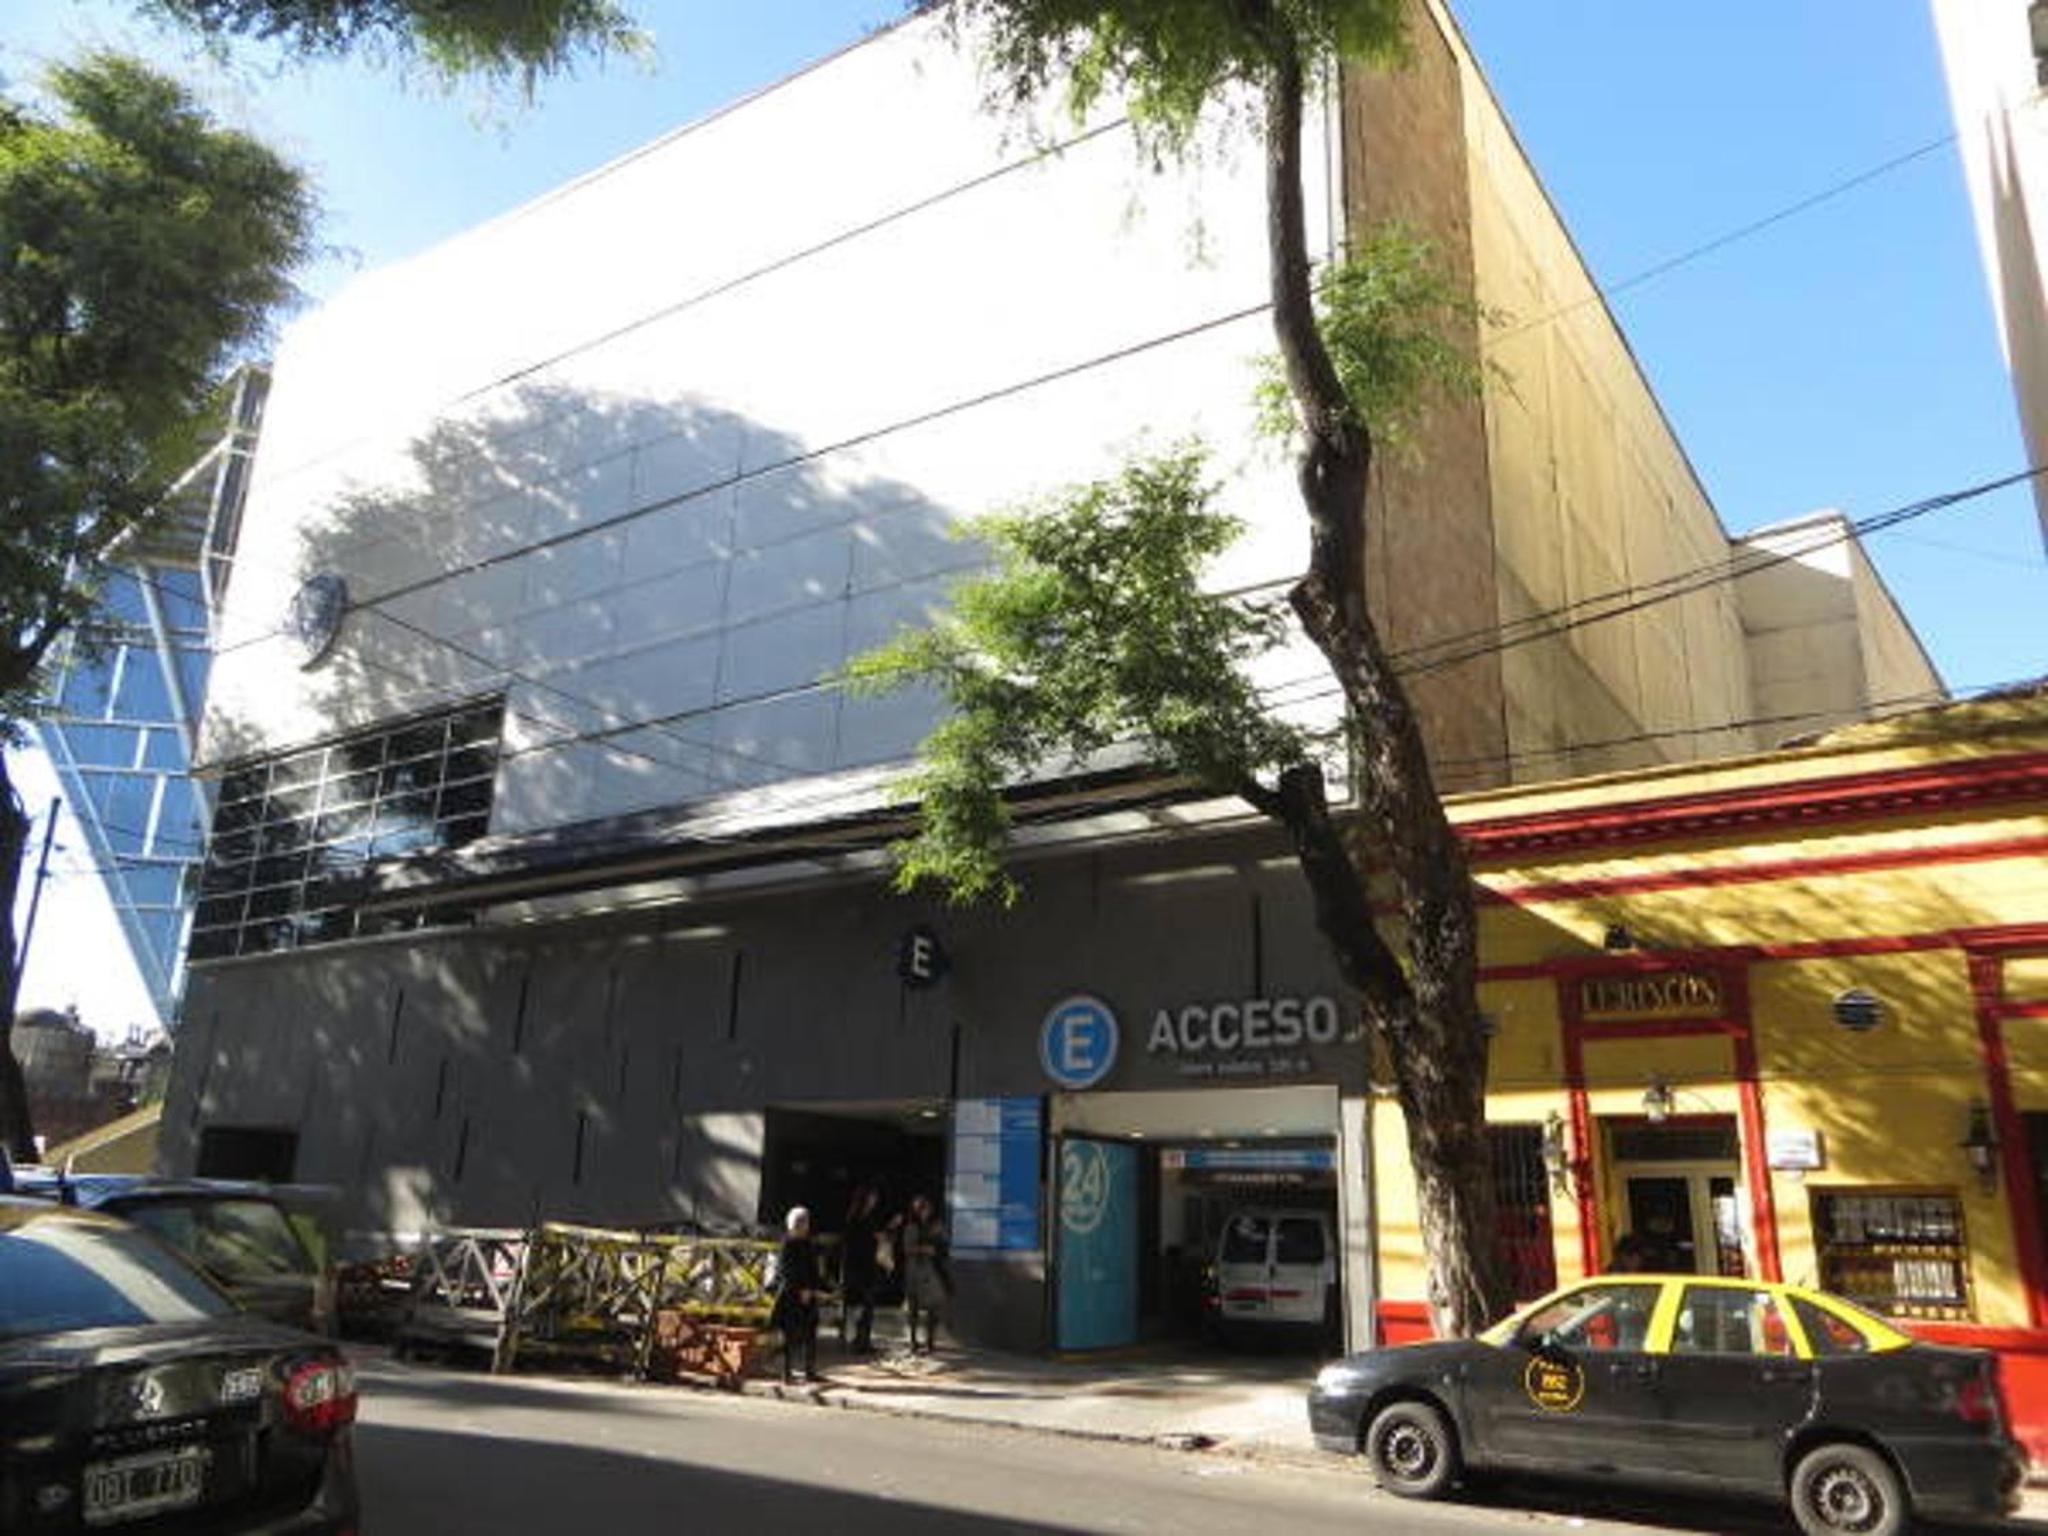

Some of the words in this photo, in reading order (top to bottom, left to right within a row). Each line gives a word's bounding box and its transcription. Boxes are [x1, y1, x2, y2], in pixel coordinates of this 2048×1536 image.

[911, 935, 930, 978] E
[1062, 1014, 1093, 1069] E
[1147, 996, 1339, 1052] ACCESO
[1062, 1152, 1099, 1198] 24
